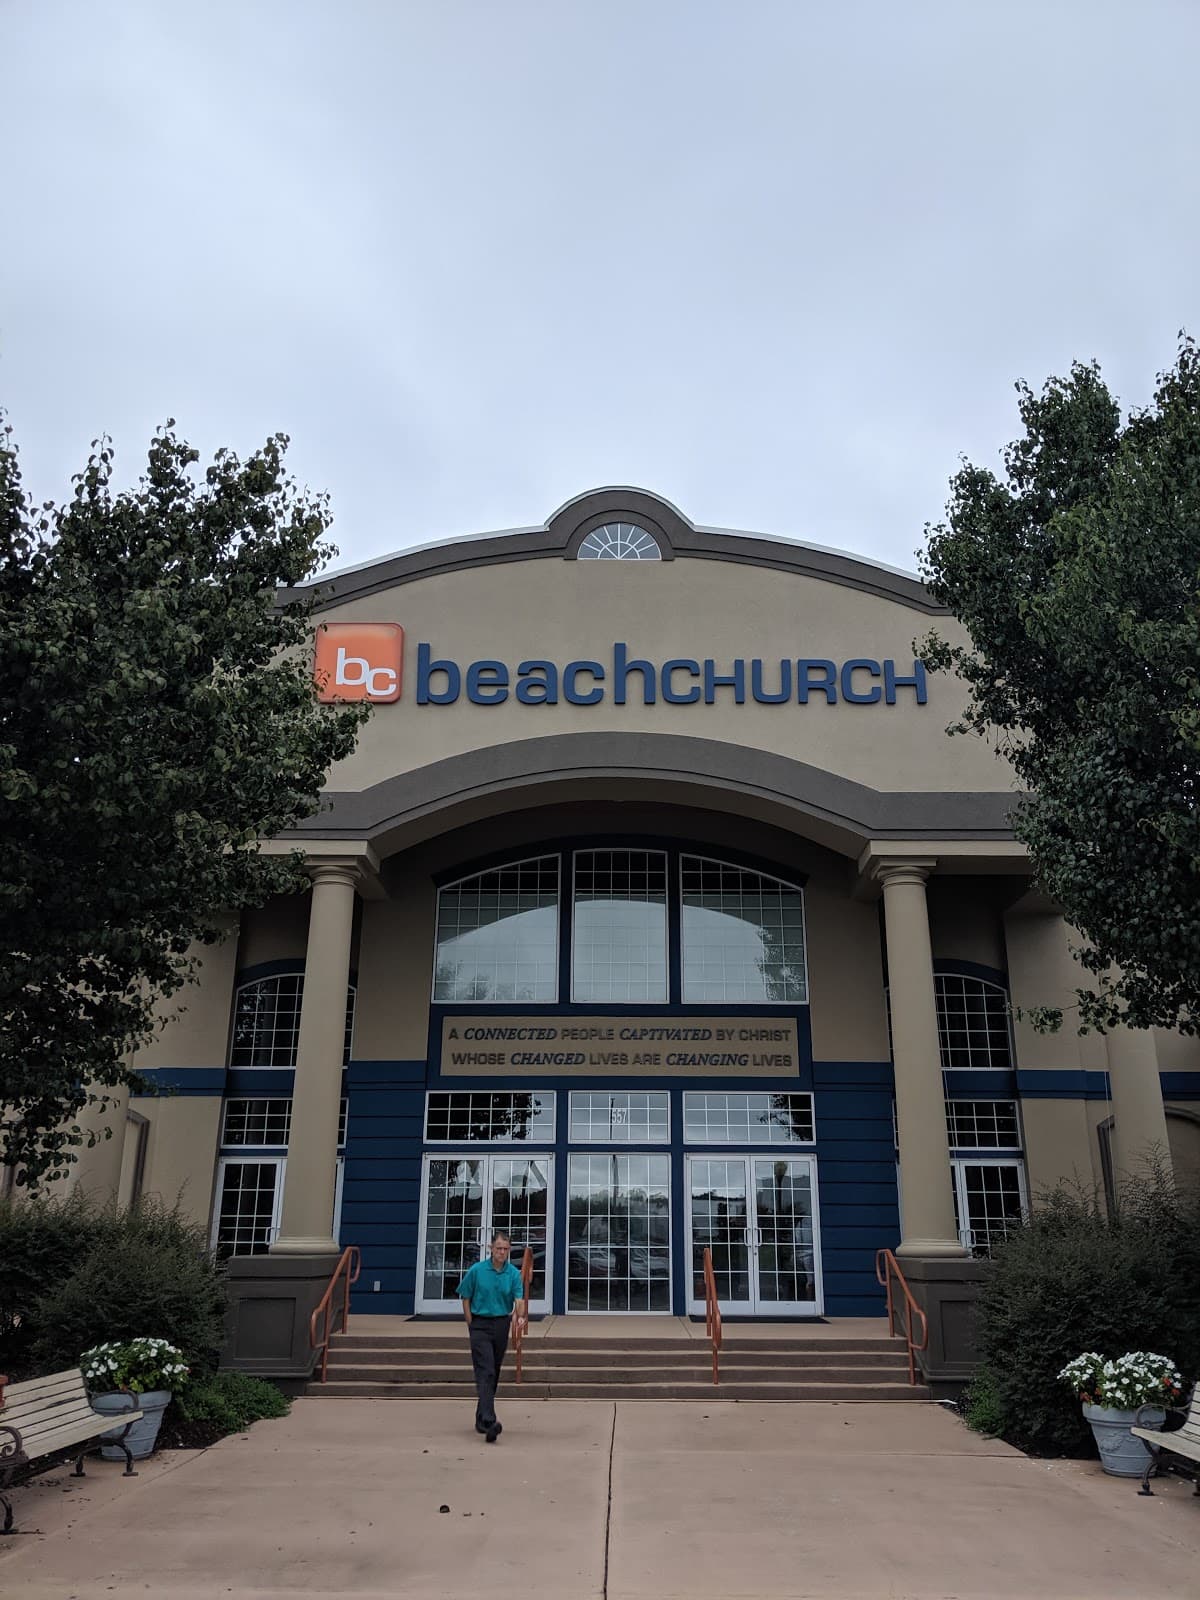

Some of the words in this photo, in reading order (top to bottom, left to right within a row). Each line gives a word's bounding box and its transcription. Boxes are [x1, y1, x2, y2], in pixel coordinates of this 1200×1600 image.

[335, 647, 397, 696] bc
[416, 642, 928, 705] beachCHURCH
[448, 1028, 459, 1040] A
[464, 1028, 558, 1041] CONNECTED
[561, 1029, 615, 1041] PEOPLE
[619, 1028, 712, 1041] CAPTIVATED
[716, 1029, 735, 1041] BY
[739, 1029, 791, 1042] CHRIST
[452, 1053, 506, 1065] WHOSE
[510, 1052, 586, 1066] CHANGED
[589, 1053, 629, 1066] LIVES
[632, 1053, 661, 1066] ARE
[666, 1053, 749, 1067] CHANGING
[753, 1054, 793, 1067] LIVES
[611, 1108, 627, 1124] 557
